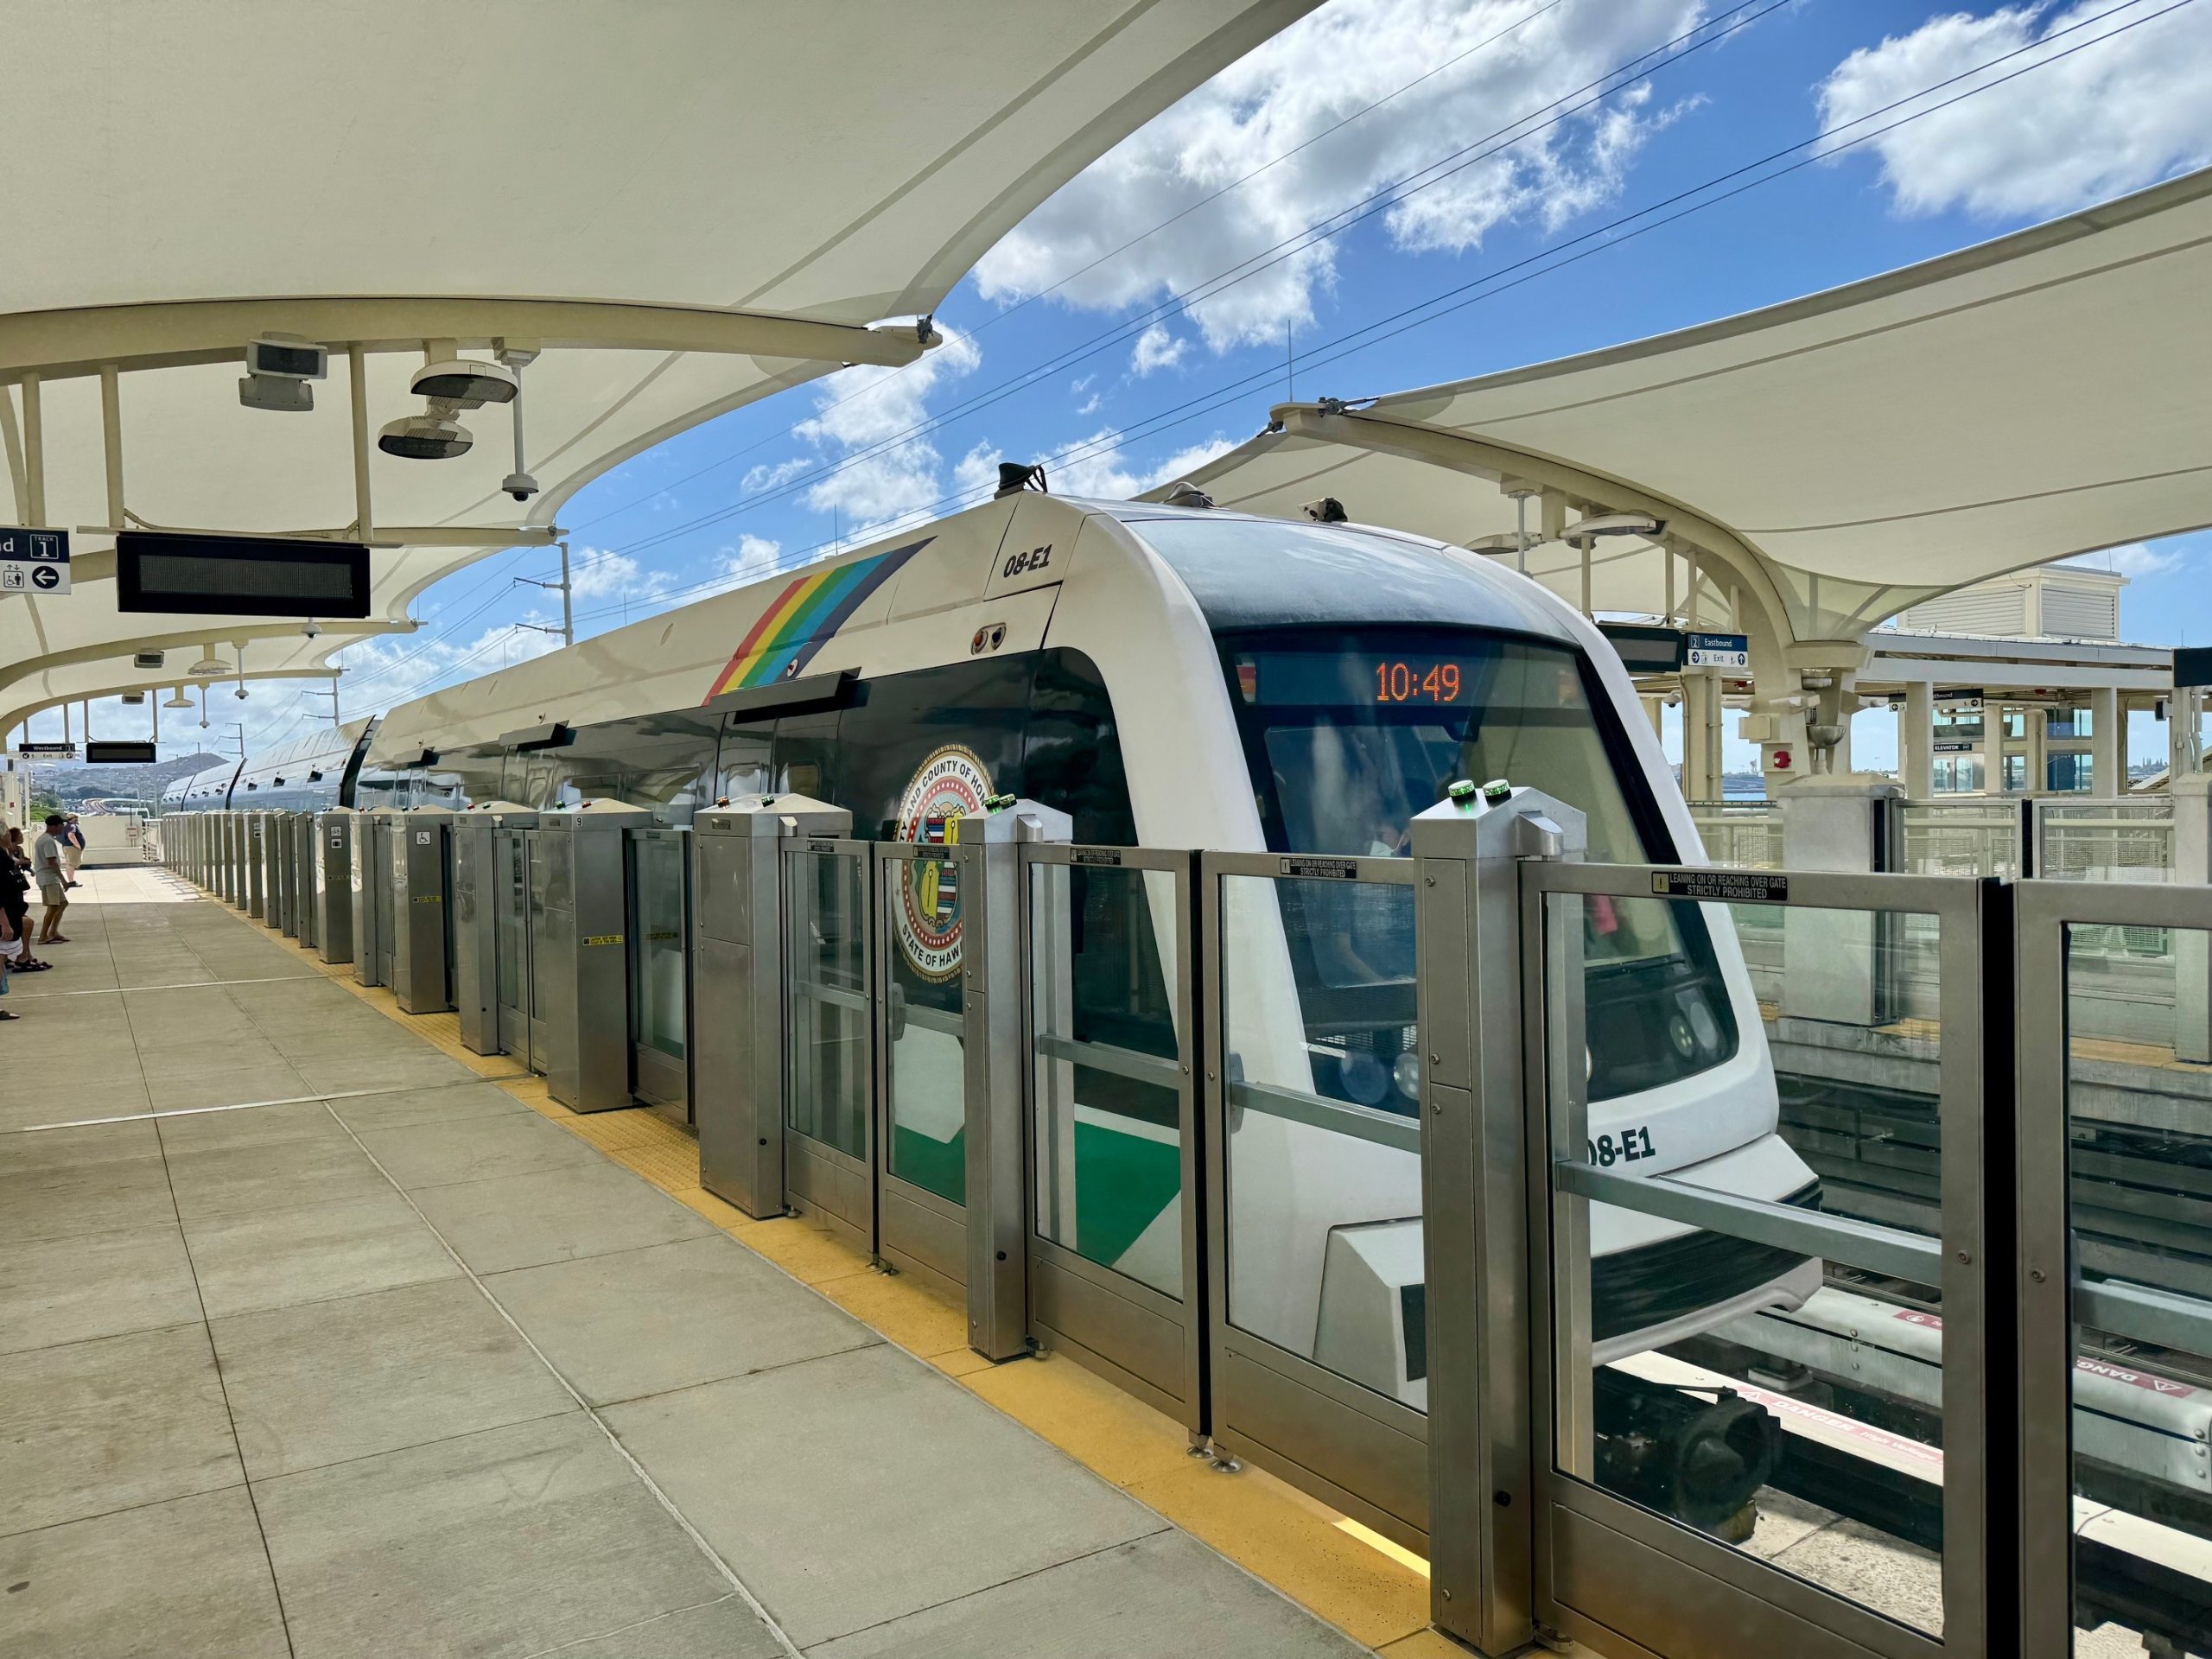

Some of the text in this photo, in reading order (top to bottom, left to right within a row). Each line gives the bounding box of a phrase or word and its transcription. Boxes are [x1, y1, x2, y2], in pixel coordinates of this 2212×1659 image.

[40, 541, 49, 557] 1
[1003, 543, 1052, 578] 08-E1
[1704, 638, 1732, 647] Eastbound
[1713, 653, 1724, 662] Exit
[1376, 662, 1459, 702] 10:49
[906, 787, 921, 817] AND
[922, 760, 957, 787] COUNTY
[960, 763, 971, 778] OF
[576, 817, 582, 827] 9
[1669, 873, 1787, 888] LEANING ON OR REACHING OVER GATE
[1688, 885, 1767, 899] STRICTLY PROHIBITED
[902, 924, 962, 967] STATE OF HAW
[2077, 1360, 2139, 1382] DANG
[1772, 1401, 1855, 1432] DANGER
